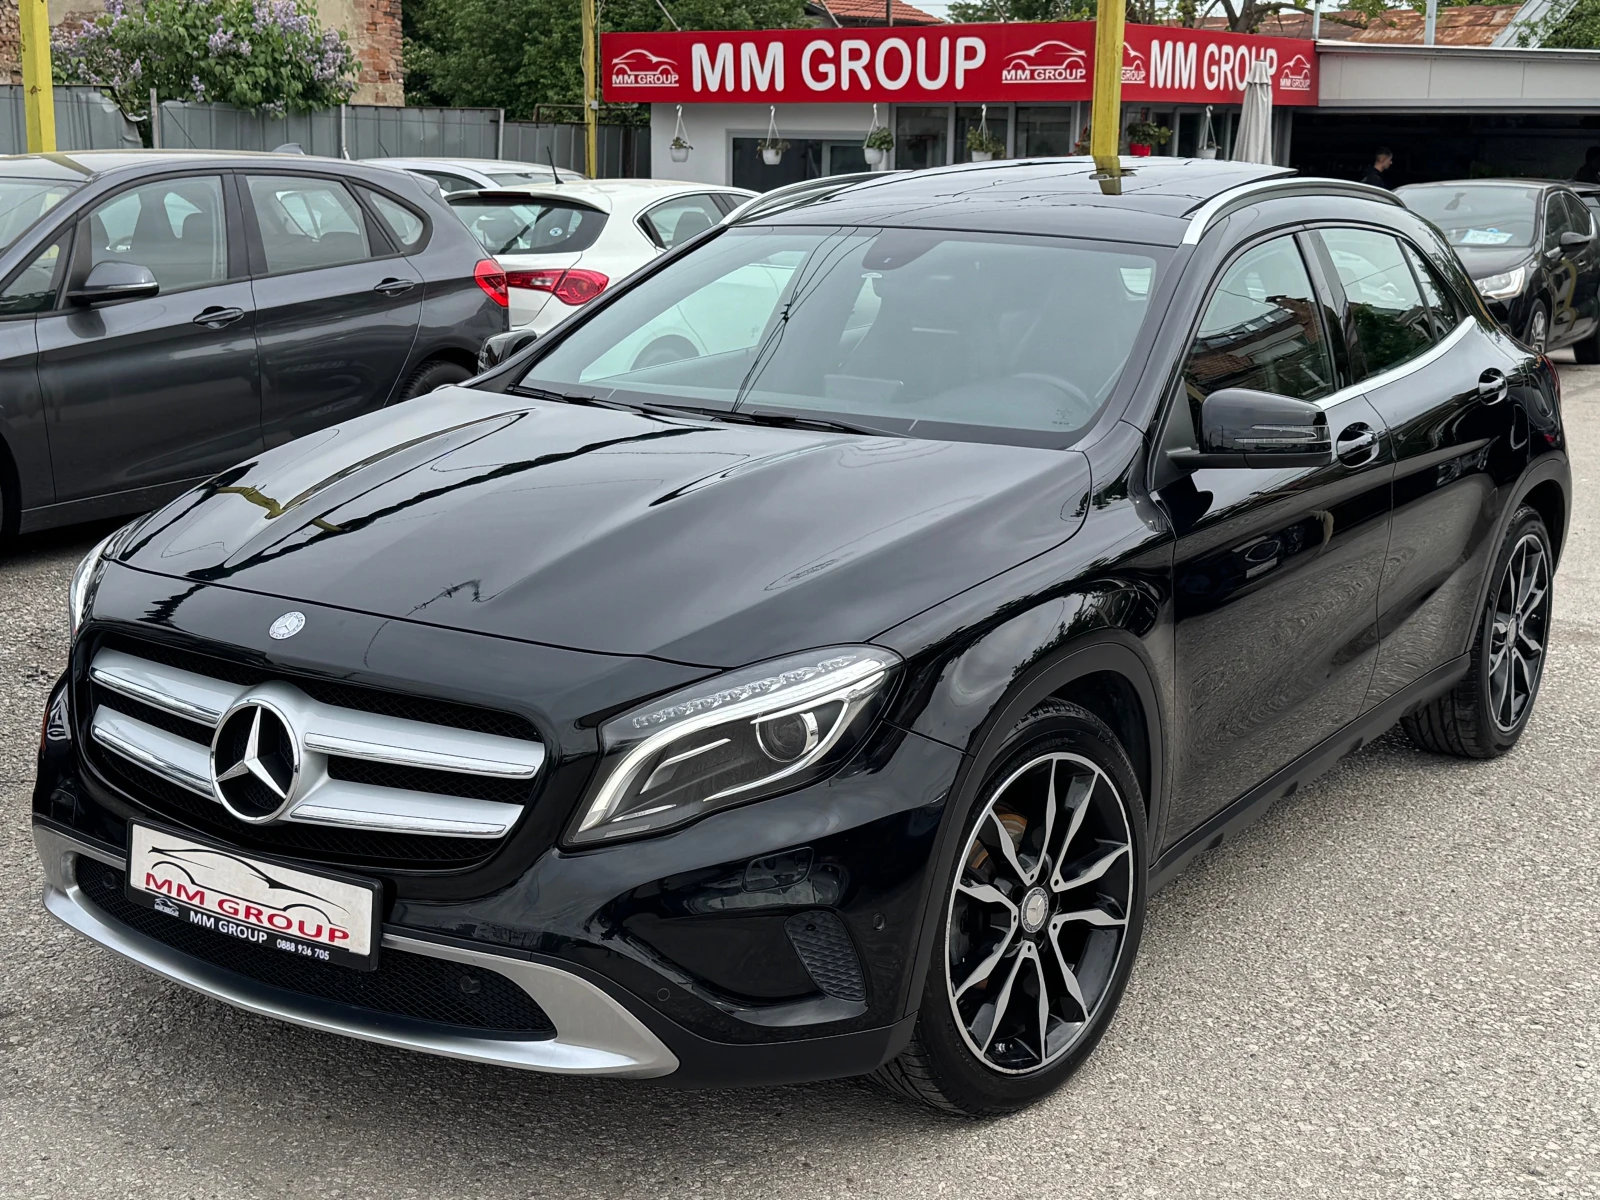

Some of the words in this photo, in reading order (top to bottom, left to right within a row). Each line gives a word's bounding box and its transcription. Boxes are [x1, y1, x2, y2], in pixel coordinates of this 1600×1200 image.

[611, 74, 635, 84] MM
[637, 73, 679, 84] GROUP
[691, 41, 785, 93] MM
[801, 36, 987, 92] GROUP
[1002, 69, 1033, 80] MM
[1034, 68, 1086, 80] GROUP
[1149, 39, 1198, 90] MM
[1292, 78, 1311, 88] GROUP
[145, 872, 205, 906] MM
[217, 898, 350, 943] GROUP
[189, 910, 215, 930] MM
[218, 916, 268, 944] GROUP
[276, 938, 296, 953] 0888
[298, 942, 312, 957] 936
[314, 946, 330, 961] 705
